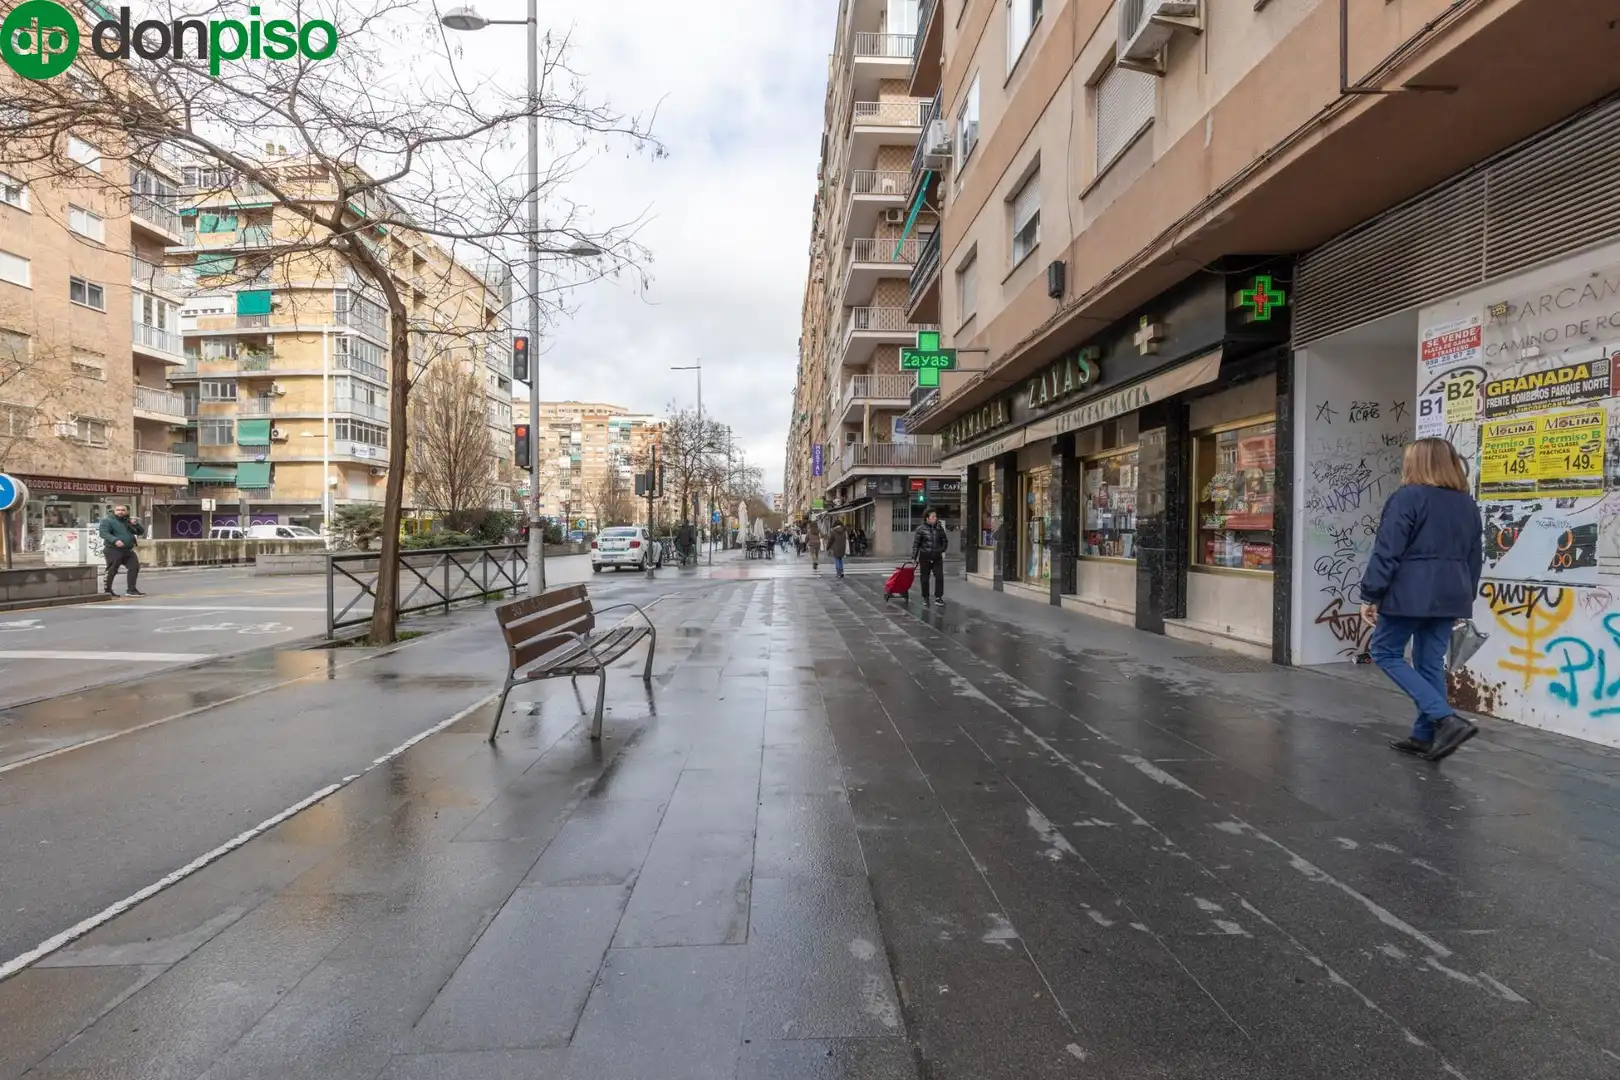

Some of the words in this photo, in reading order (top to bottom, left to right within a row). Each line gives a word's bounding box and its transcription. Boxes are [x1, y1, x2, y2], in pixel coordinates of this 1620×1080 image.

[1427, 339, 1439, 348] SE
[1441, 327, 1477, 343] VENDE
[1486, 328, 1558, 357] CAMINO
[1565, 319, 1590, 339] DE
[904, 352, 949, 367] Zayas
[1027, 347, 1096, 409] ZAYAS
[1487, 365, 1590, 397] GRANADA
[1447, 379, 1475, 401] B2
[1486, 393, 1510, 409] FRENTE
[1551, 380, 1581, 398] PARQUE
[1582, 376, 1609, 392] NORTE
[1420, 396, 1443, 417] B1
[1488, 425, 1534, 437] MOLINA
[1545, 416, 1600, 430] MOLINA
[1485, 437, 1524, 450] Permiso
[1528, 437, 1536, 445] B
[1541, 431, 1588, 444] Permiso
[1591, 430, 1600, 439] B
[63, 481, 73, 490] DE
